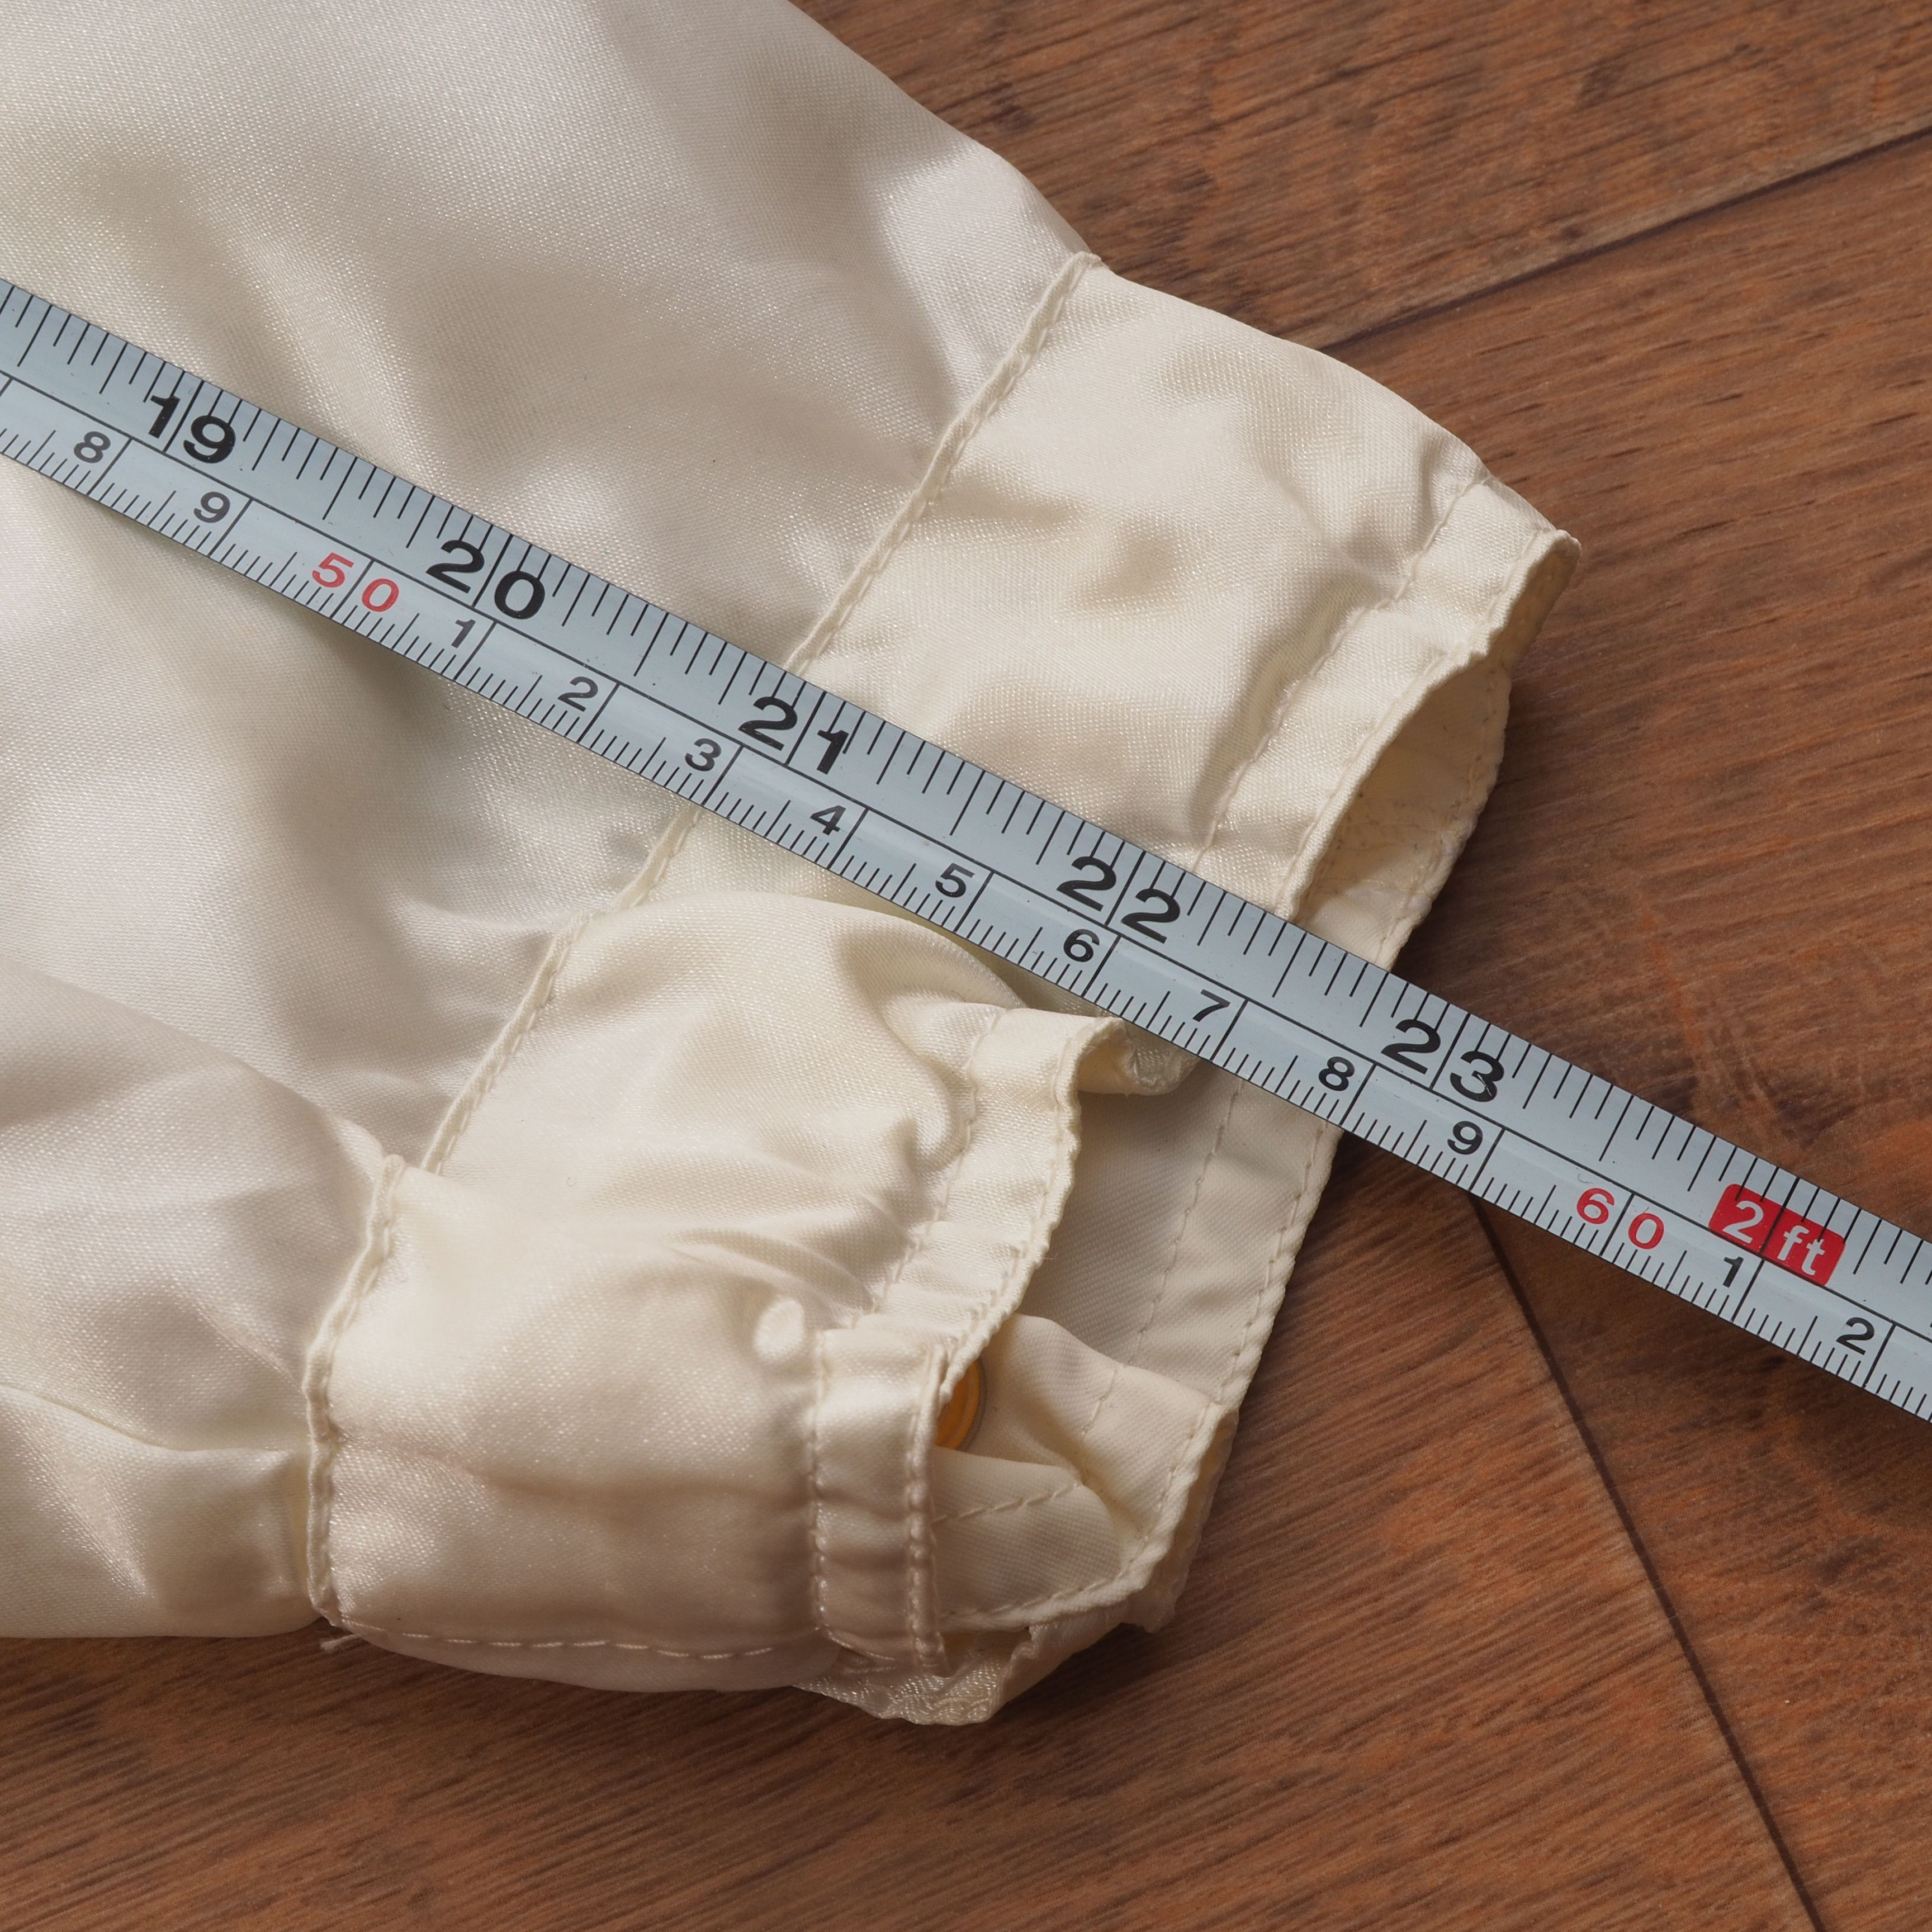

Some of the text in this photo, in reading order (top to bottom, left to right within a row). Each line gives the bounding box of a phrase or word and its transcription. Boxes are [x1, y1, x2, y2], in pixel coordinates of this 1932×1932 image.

[73, 431, 1875, 1356] 8 9 50 1 2 3 4 5 6 7 8 9 60 1 2
[148, 395, 1826, 1276] 19 20 21 22 23 2 ft
